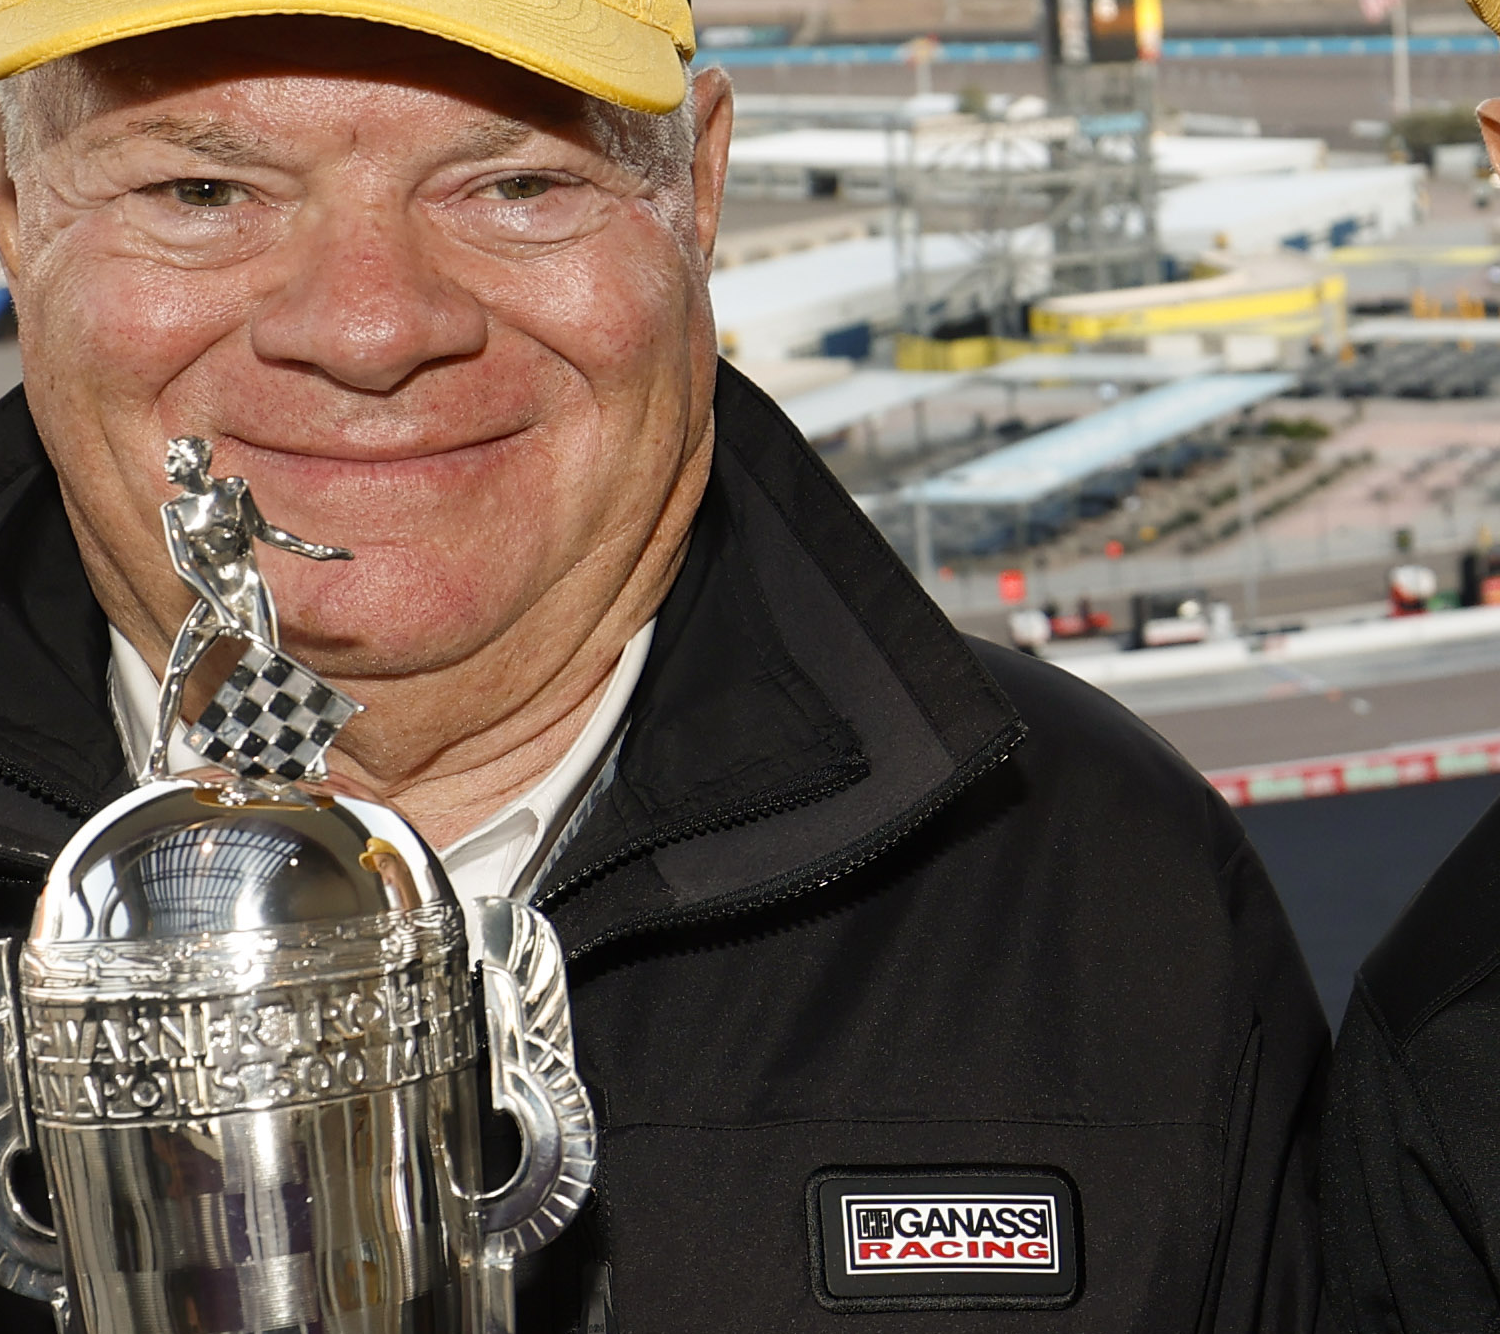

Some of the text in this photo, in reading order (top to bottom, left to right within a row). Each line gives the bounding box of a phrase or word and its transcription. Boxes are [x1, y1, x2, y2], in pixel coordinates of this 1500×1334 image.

[858, 1207, 1047, 1240] CHIP GANASSI
[858, 1241, 1050, 1260] RACING
